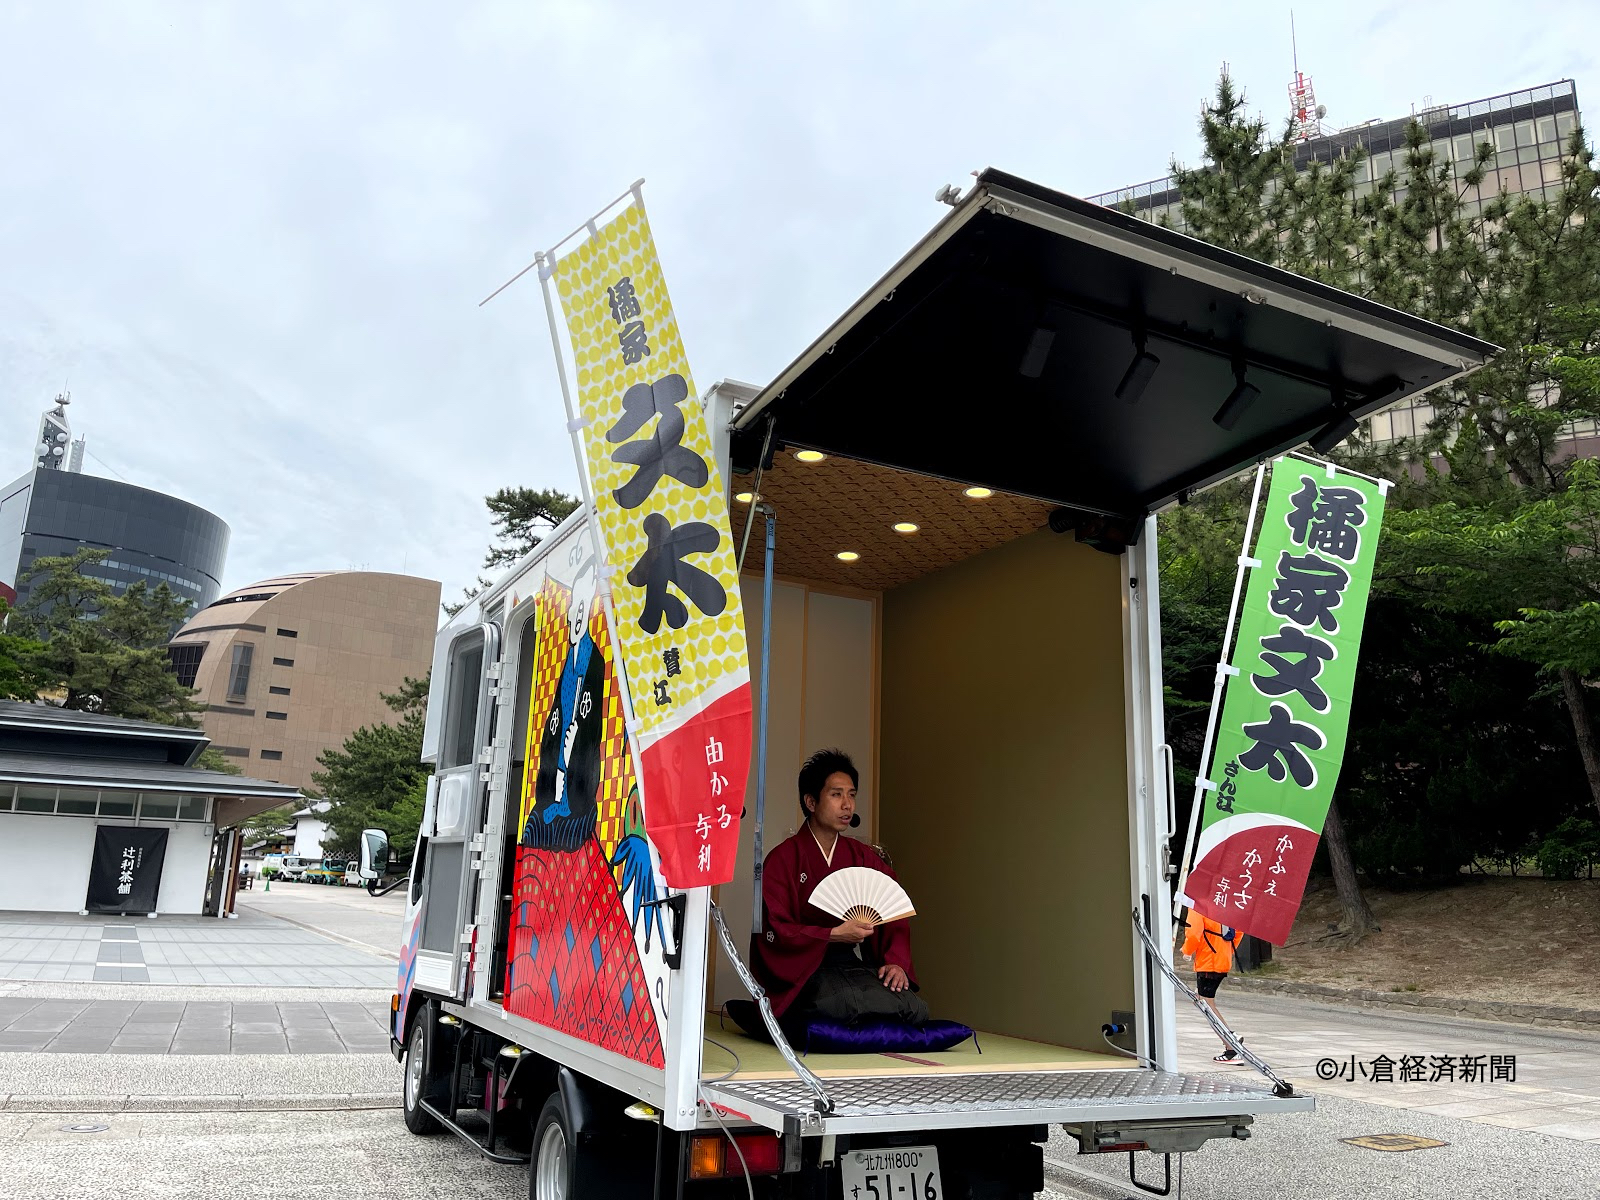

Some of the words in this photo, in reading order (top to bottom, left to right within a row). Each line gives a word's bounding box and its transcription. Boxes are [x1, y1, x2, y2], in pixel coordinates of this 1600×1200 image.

[607, 276, 651, 366] 橘家
[606, 373, 727, 635] 文太
[1236, 474, 1369, 791] 橘家文太
[704, 736, 732, 831] 由かる
[695, 813, 712, 873] 与利
[1213, 876, 1231, 908] 与利
[1233, 848, 1262, 910] かうさ
[865, 1152, 919, 1171] 北九州800
[865, 1171, 937, 1200] 51-16
